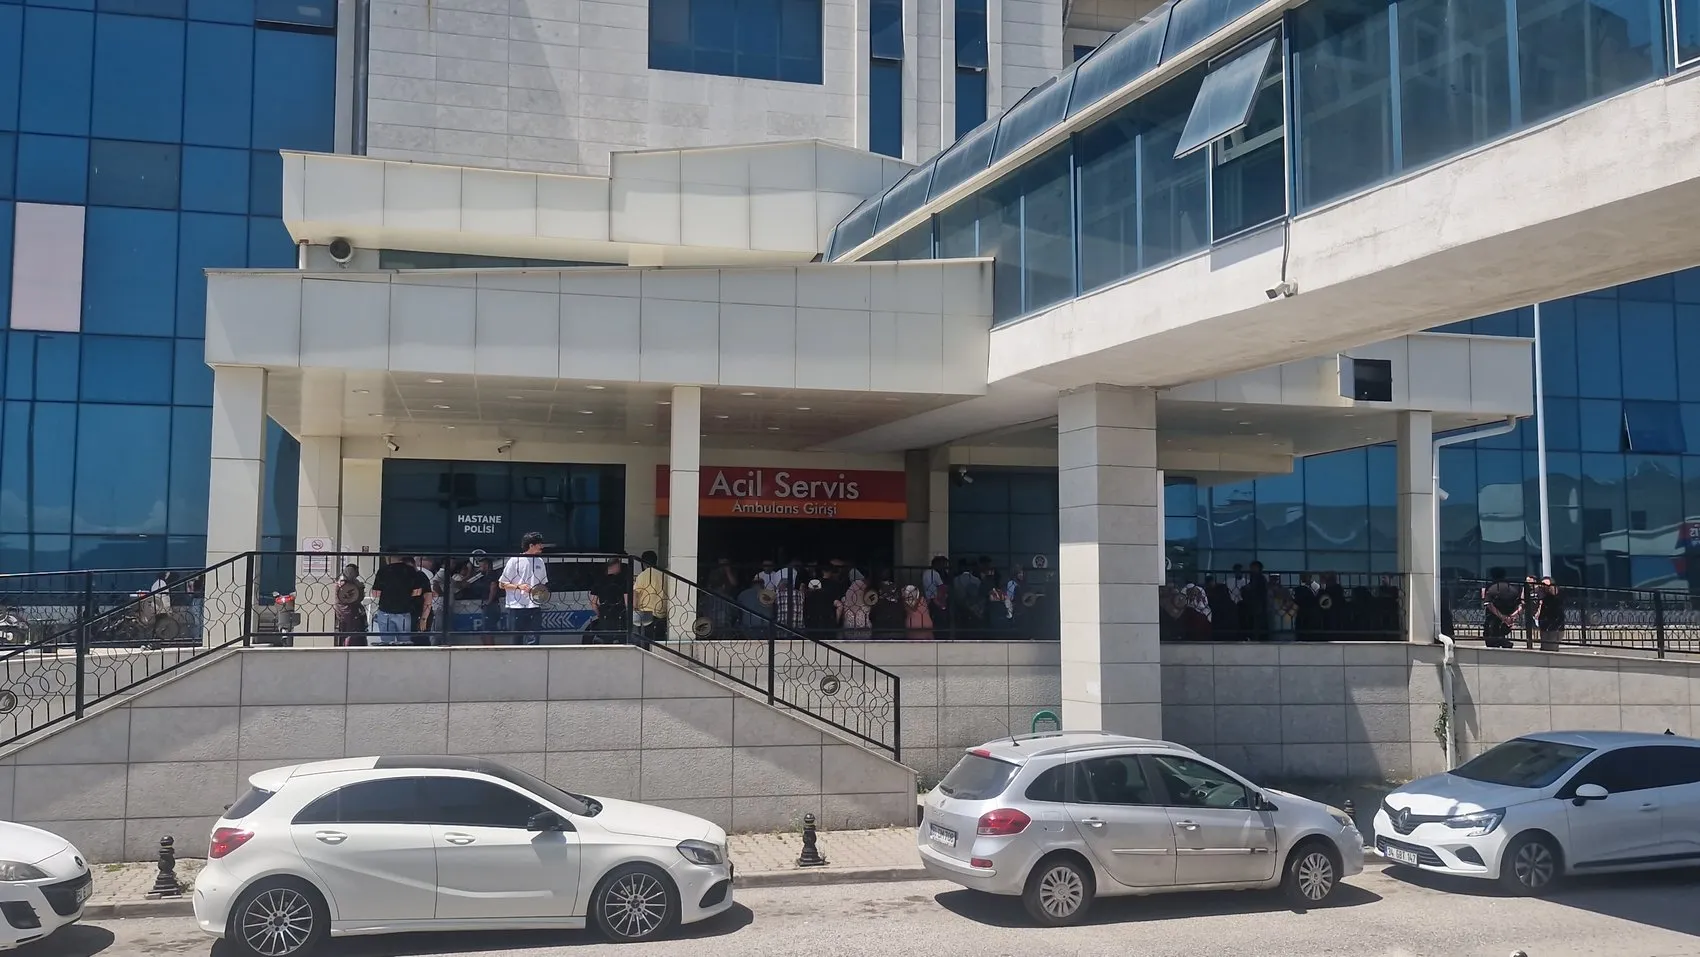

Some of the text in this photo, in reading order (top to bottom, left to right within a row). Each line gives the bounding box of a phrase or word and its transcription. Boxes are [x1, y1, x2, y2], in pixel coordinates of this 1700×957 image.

[708, 470, 860, 500] Acil Servis
[731, 500, 837, 517] Ambulans Girişi
[457, 514, 502, 524] HASTANE
[464, 523, 495, 534] POLİSİ
